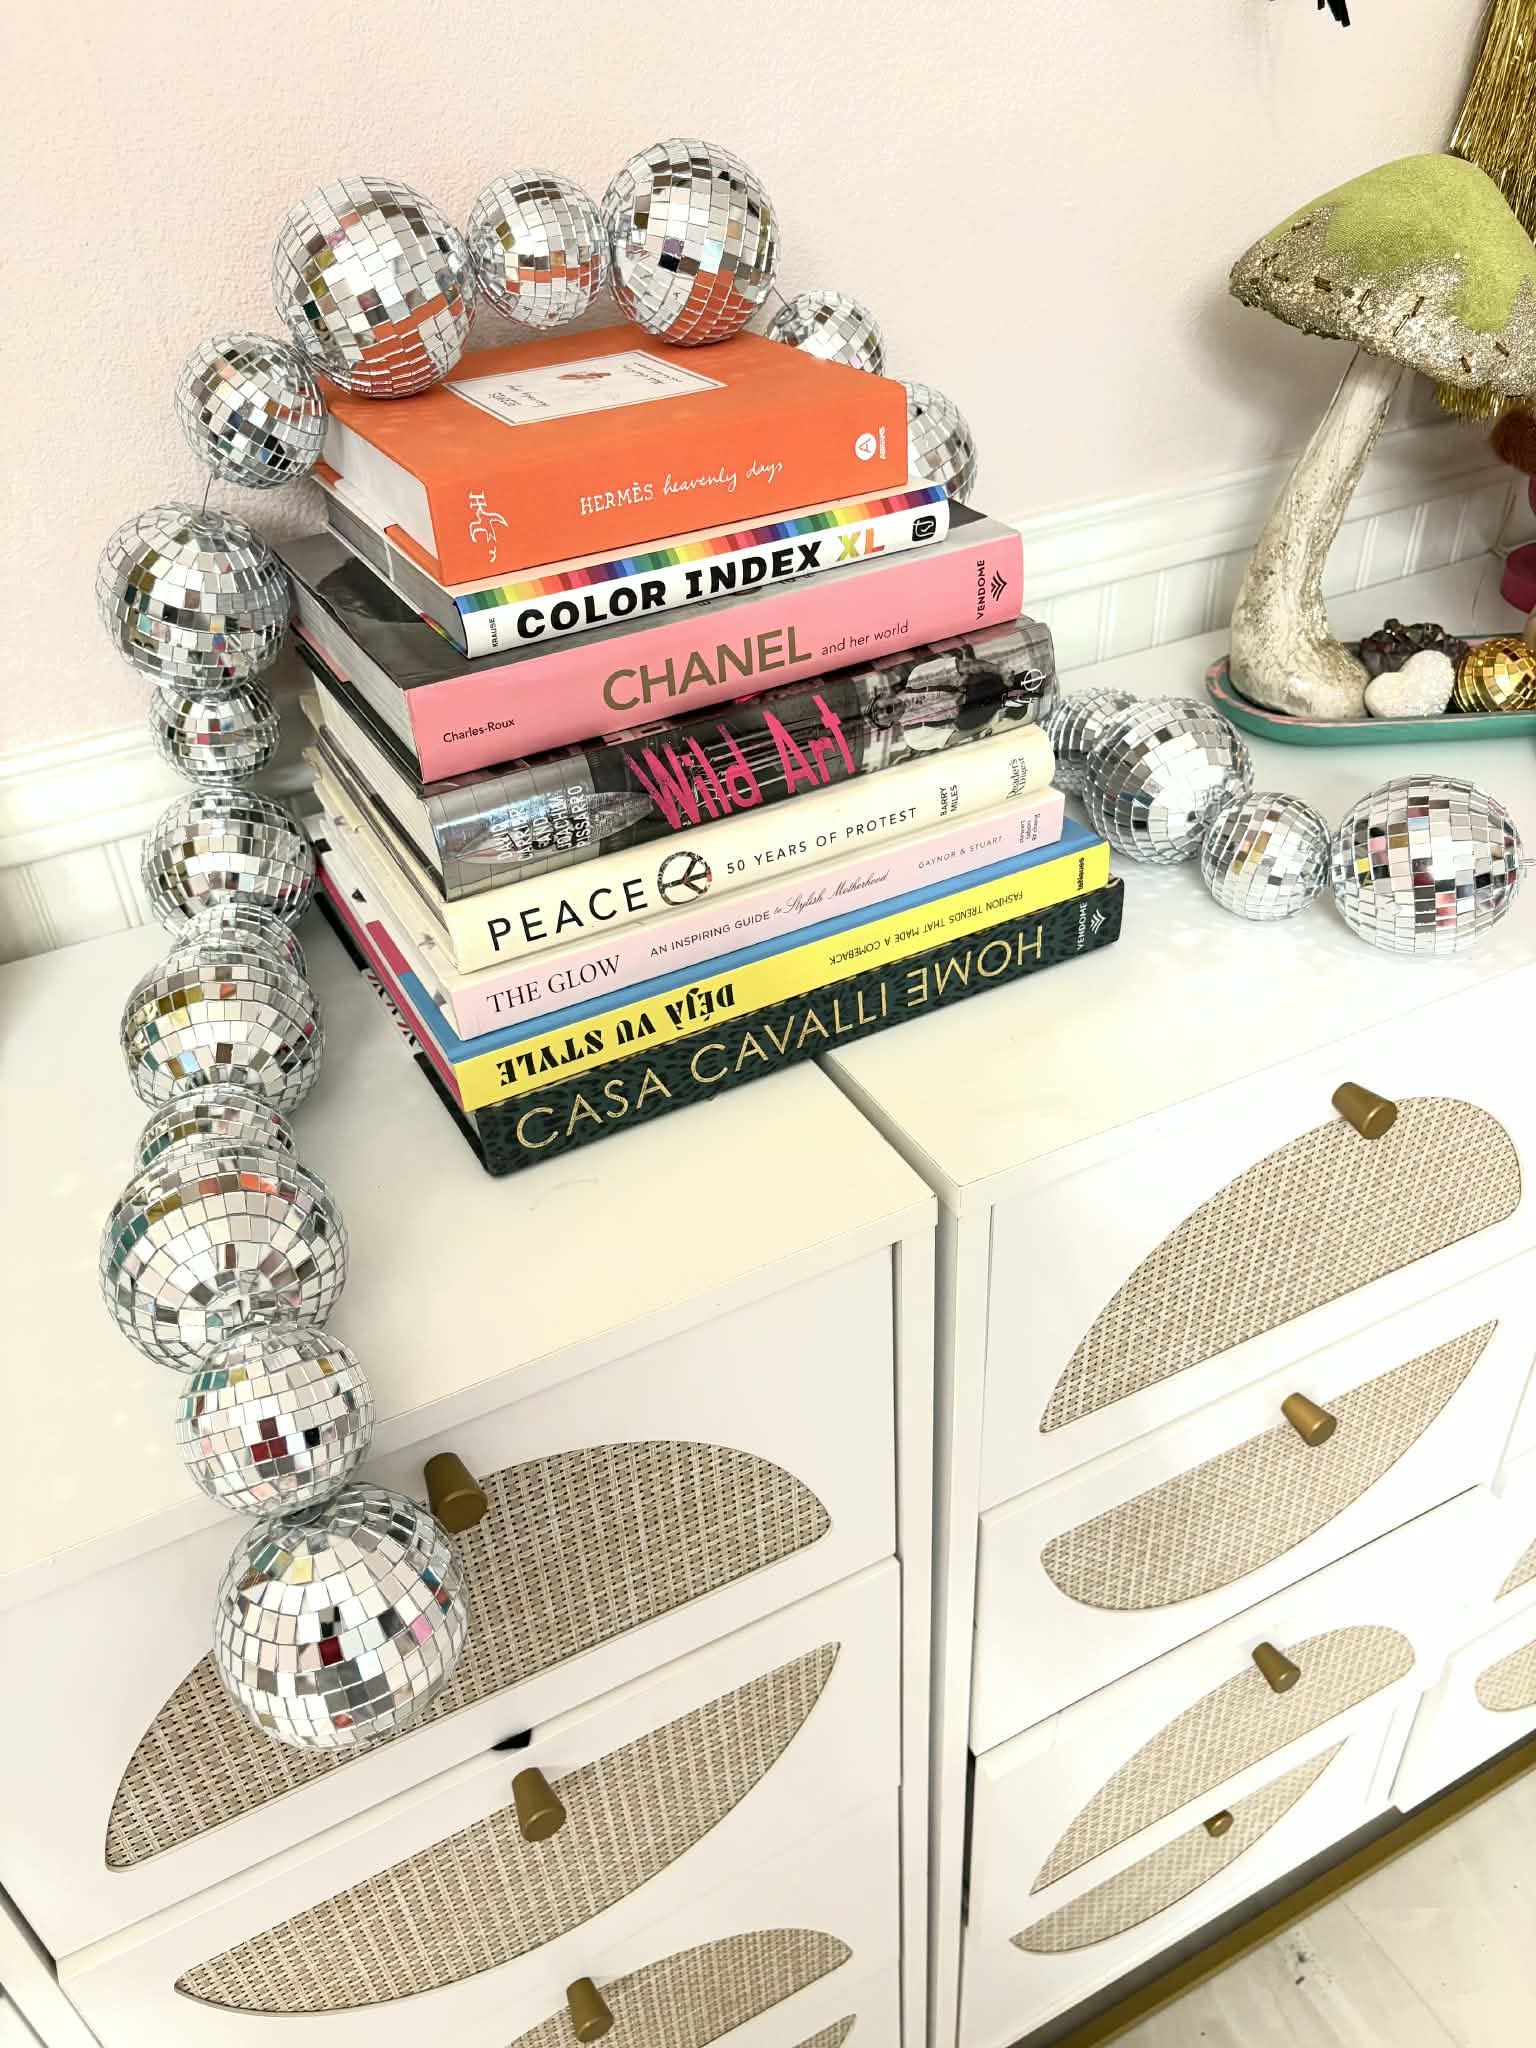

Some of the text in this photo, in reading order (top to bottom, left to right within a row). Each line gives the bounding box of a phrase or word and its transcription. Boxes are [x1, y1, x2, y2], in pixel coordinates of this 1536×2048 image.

[663, 467, 738, 494] heavenly
[745, 459, 784, 484] days
[516, 528, 886, 639] COLOR INDEX XL
[976, 559, 986, 620] VENDOME
[488, 617, 499, 648] KRAUSE
[603, 621, 909, 711] CHANEL and her world
[443, 718, 516, 744] Charles-Roux
[623, 694, 857, 830] Wild Art
[1005, 756, 1020, 799] Reader's
[567, 784, 593, 849] PISSARRO
[939, 786, 948, 817] BARRY
[949, 784, 959, 813] MILES
[531, 815, 551, 849] AND
[726, 807, 918, 875] 50 YEARS OF PROTEST
[918, 835, 1002, 869] GAYNOR & STUART
[487, 878, 649, 951] PEACE
[650, 946, 668, 958] AN
[671, 924, 731, 950] INSPIRING
[734, 911, 771, 930] GUIDE
[781, 893, 824, 916] Stylish
[826, 870, 890, 901] Motherhood
[829, 890, 1023, 966] FASHION TRENDS THAT MADE A COMEBACK
[1077, 901, 1088, 951] VENDOME
[486, 955, 621, 1013] THE GLOW
[906, 925, 1043, 1008] HOME
[495, 1029, 605, 1087] STYLE
[615, 1012, 657, 1046] VU
[516, 982, 887, 1149] CASA CAVALLI
